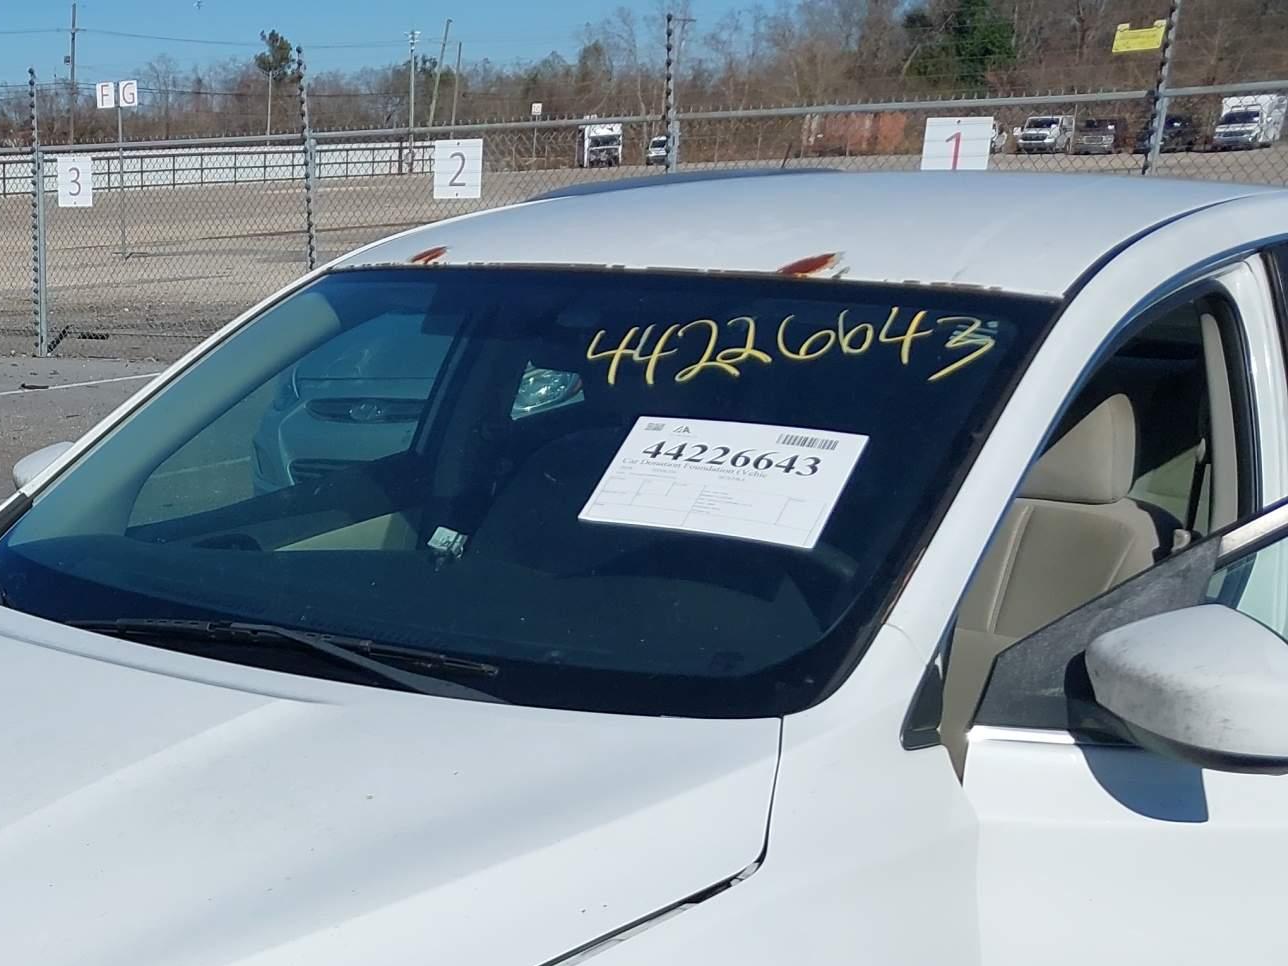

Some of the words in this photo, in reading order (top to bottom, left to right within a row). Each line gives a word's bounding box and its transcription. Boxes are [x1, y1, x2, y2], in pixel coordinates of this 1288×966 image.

[100, 84, 109, 106] F
[122, 82, 136, 104] G
[944, 131, 961, 170] 1
[68, 167, 81, 197] 3
[448, 151, 467, 187] 2
[586, 306, 996, 385] 44226643
[642, 440, 822, 477] 44226643
